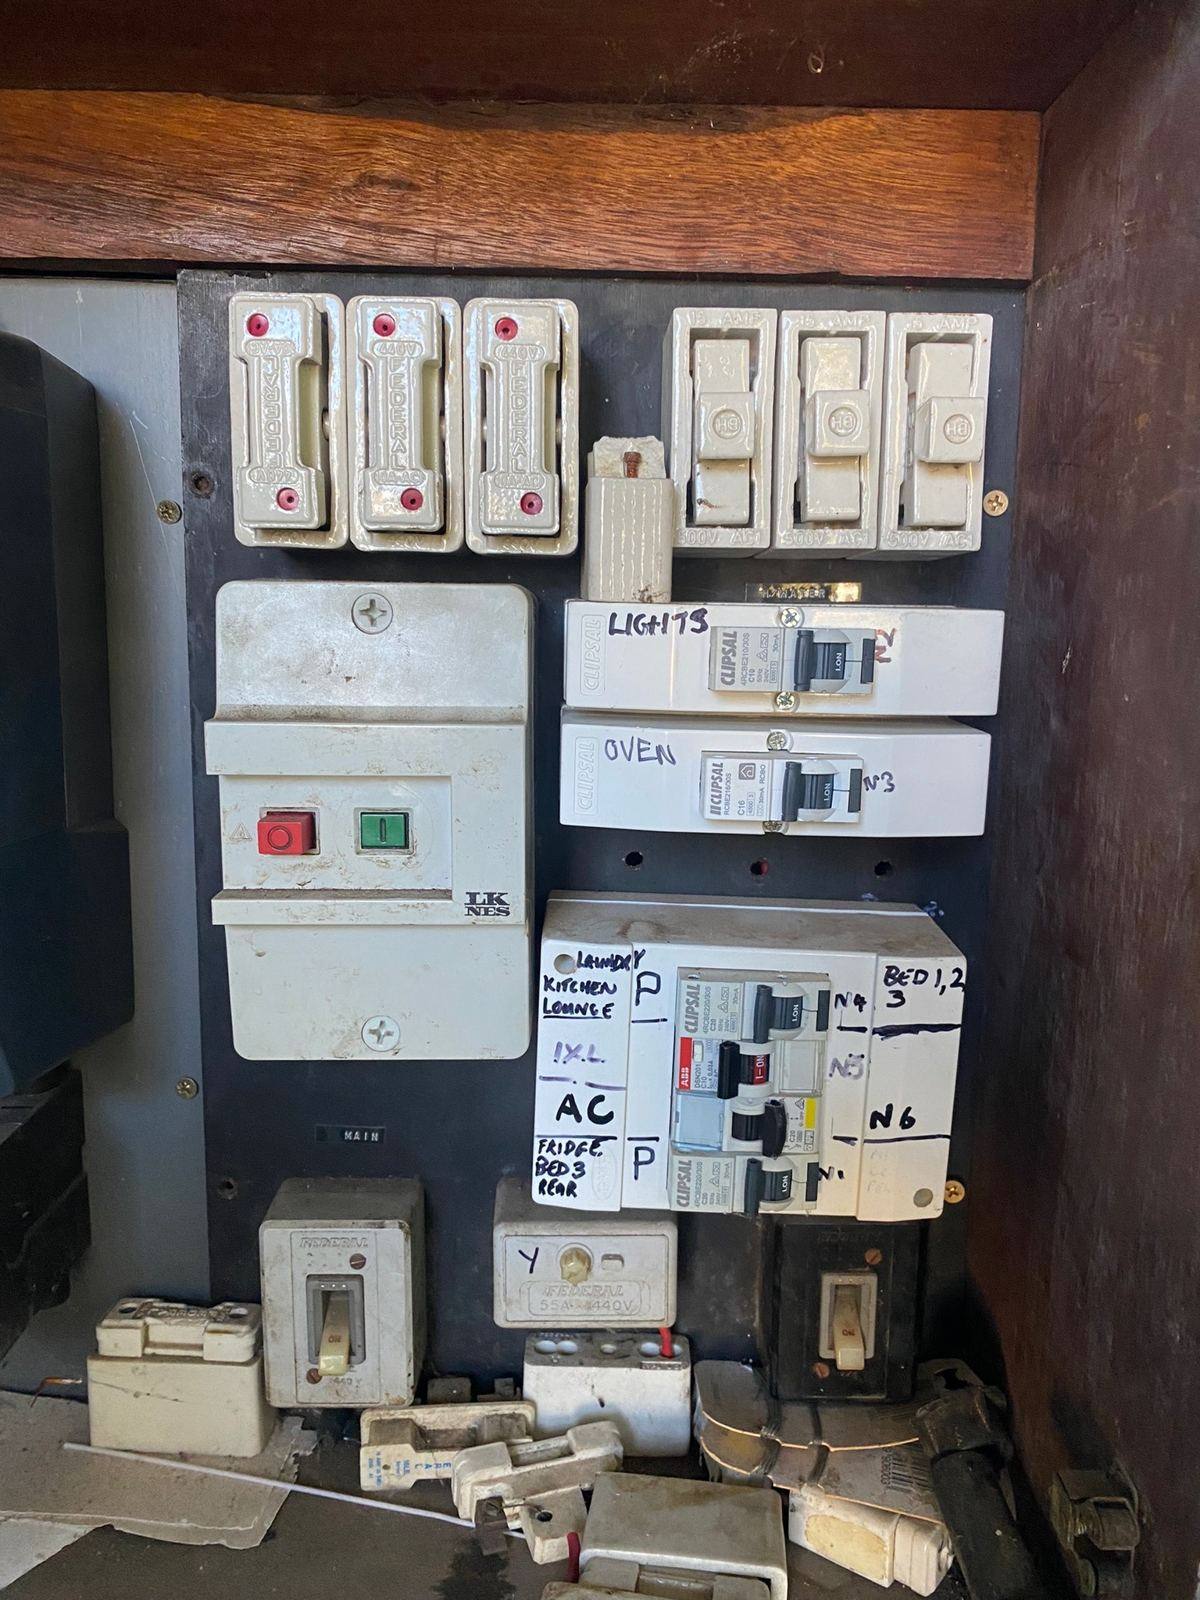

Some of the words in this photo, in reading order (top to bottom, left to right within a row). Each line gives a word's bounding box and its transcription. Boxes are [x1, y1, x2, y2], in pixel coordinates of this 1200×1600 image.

[722, 310, 761, 325] AMP
[832, 314, 870, 328] AMP
[939, 317, 978, 330] AMP
[377, 343, 417, 356] 440V
[500, 346, 540, 359] 440V
[267, 355, 282, 467] FEDERAL
[389, 358, 406, 469] FEDERAL
[509, 362, 528, 473] FEDERAL
[782, 530, 824, 546] 500V
[887, 531, 928, 547] 500V
[608, 606, 709, 636] LIGHTS
[582, 618, 602, 693] CLIPSAL
[720, 631, 737, 686] CLIPSAL
[604, 738, 676, 766] OVEN
[579, 739, 597, 815] CLIPSAL
[758, 764, 766, 785] RCBO
[737, 799, 745, 816] C16
[463, 891, 510, 906] LK
[463, 906, 511, 917] NES
[576, 949, 646, 972] LAUNDRY
[543, 974, 617, 996] KITCHEN
[882, 965, 930, 988] BED
[635, 971, 662, 1006] P
[885, 989, 906, 1008] 3
[543, 997, 614, 1019] LOUNGE
[684, 984, 700, 1034] CLIPSAL
[681, 1066, 689, 1087] ABB
[555, 1092, 614, 1126] AC
[344, 1130, 379, 1142] MAIN
[535, 1155, 570, 1177] BED
[571, 1160, 586, 1180] 3
[632, 1146, 656, 1181] P
[537, 1178, 578, 1198] REAR
[676, 1160, 692, 1208] CLIPSAL
[299, 1237, 369, 1249] FEDERAL
[518, 1246, 540, 1275] Y
[543, 1284, 624, 1299] FEDERAL
